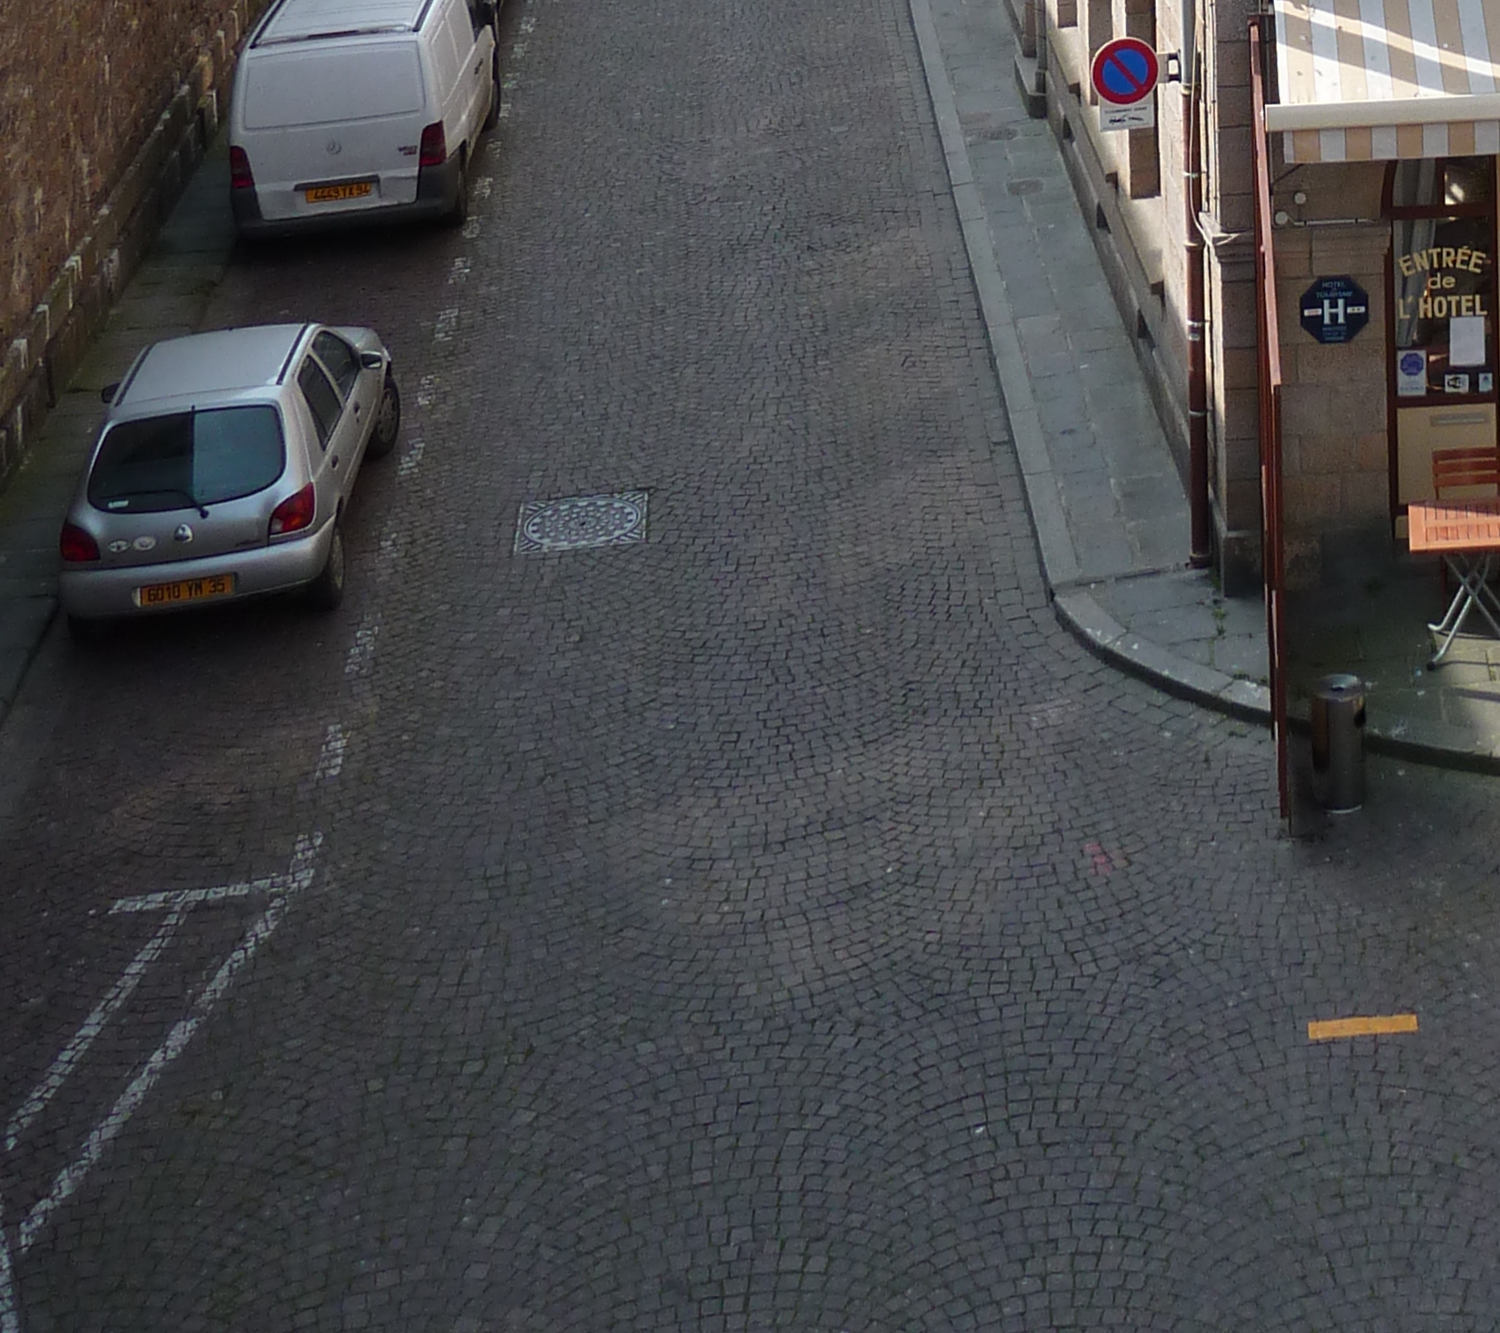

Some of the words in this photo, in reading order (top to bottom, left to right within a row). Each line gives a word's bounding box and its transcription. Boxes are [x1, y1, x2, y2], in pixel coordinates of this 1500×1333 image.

[1398, 245, 1487, 277] ENTRÉE
[1428, 272, 1456, 290] de
[1322, 298, 1346, 325] H
[148, 585, 180, 602] 6010
[208, 577, 225, 593] 35
